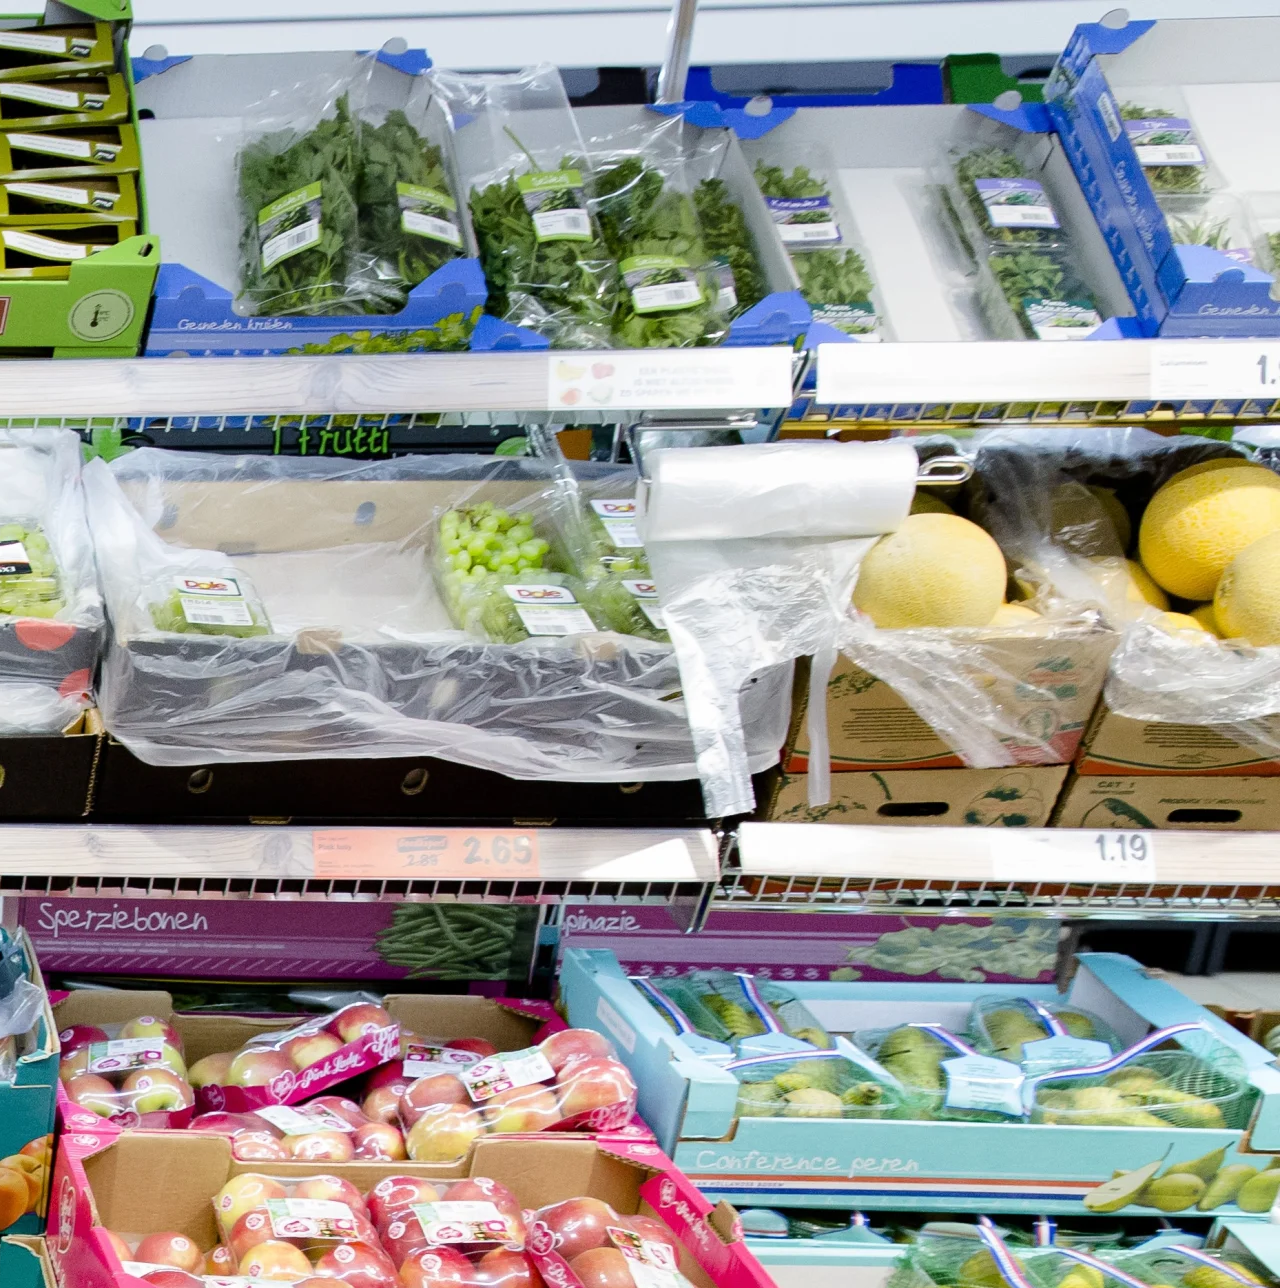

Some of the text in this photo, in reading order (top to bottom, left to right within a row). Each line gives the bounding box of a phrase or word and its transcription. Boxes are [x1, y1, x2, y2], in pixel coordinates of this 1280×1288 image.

[184, 579, 228, 591] Dole
[517, 589, 562, 599] Dole
[462, 836, 533, 865] 2.65
[1094, 833, 1146, 861] 1.19
[39, 901, 208, 937] Sperziebonen
[562, 910, 641, 937] pinazie
[696, 1149, 920, 1179] Conference peren
